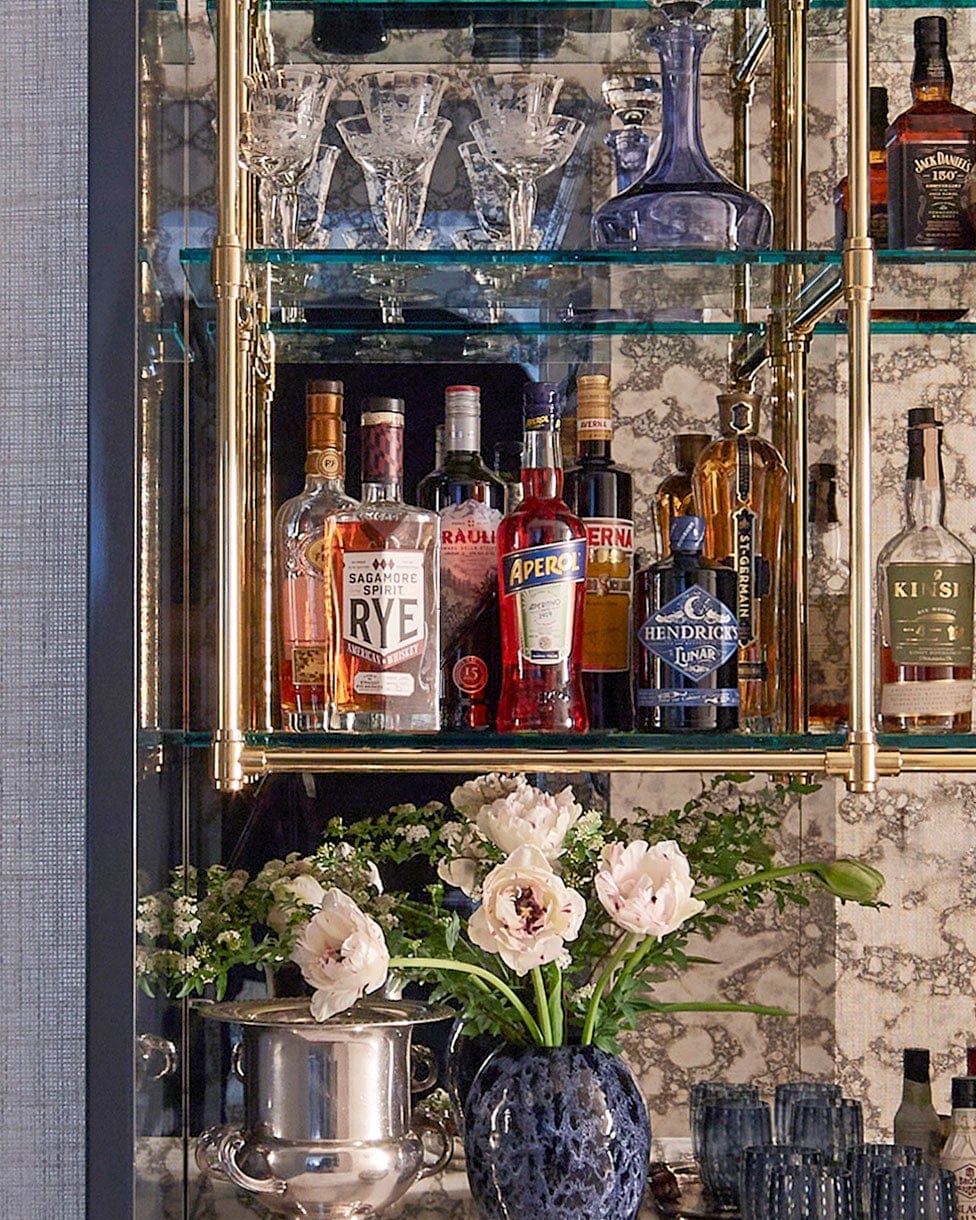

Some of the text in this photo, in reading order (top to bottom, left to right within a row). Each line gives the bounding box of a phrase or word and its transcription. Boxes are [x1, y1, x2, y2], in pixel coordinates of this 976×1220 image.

[914, 151, 973, 174] JACK DANIEL'S
[441, 527, 495, 545] RÀULI
[588, 527, 633, 549] ERNA
[348, 572, 418, 584] SAGAMORE
[509, 551, 580, 587] APEROL
[363, 584, 404, 596] SPIRIT
[349, 598, 418, 650] RYE
[644, 625, 738, 641] HENDRICK'S
[346, 642, 381, 666] AMERICAN
[674, 644, 717, 667] LUNAR
